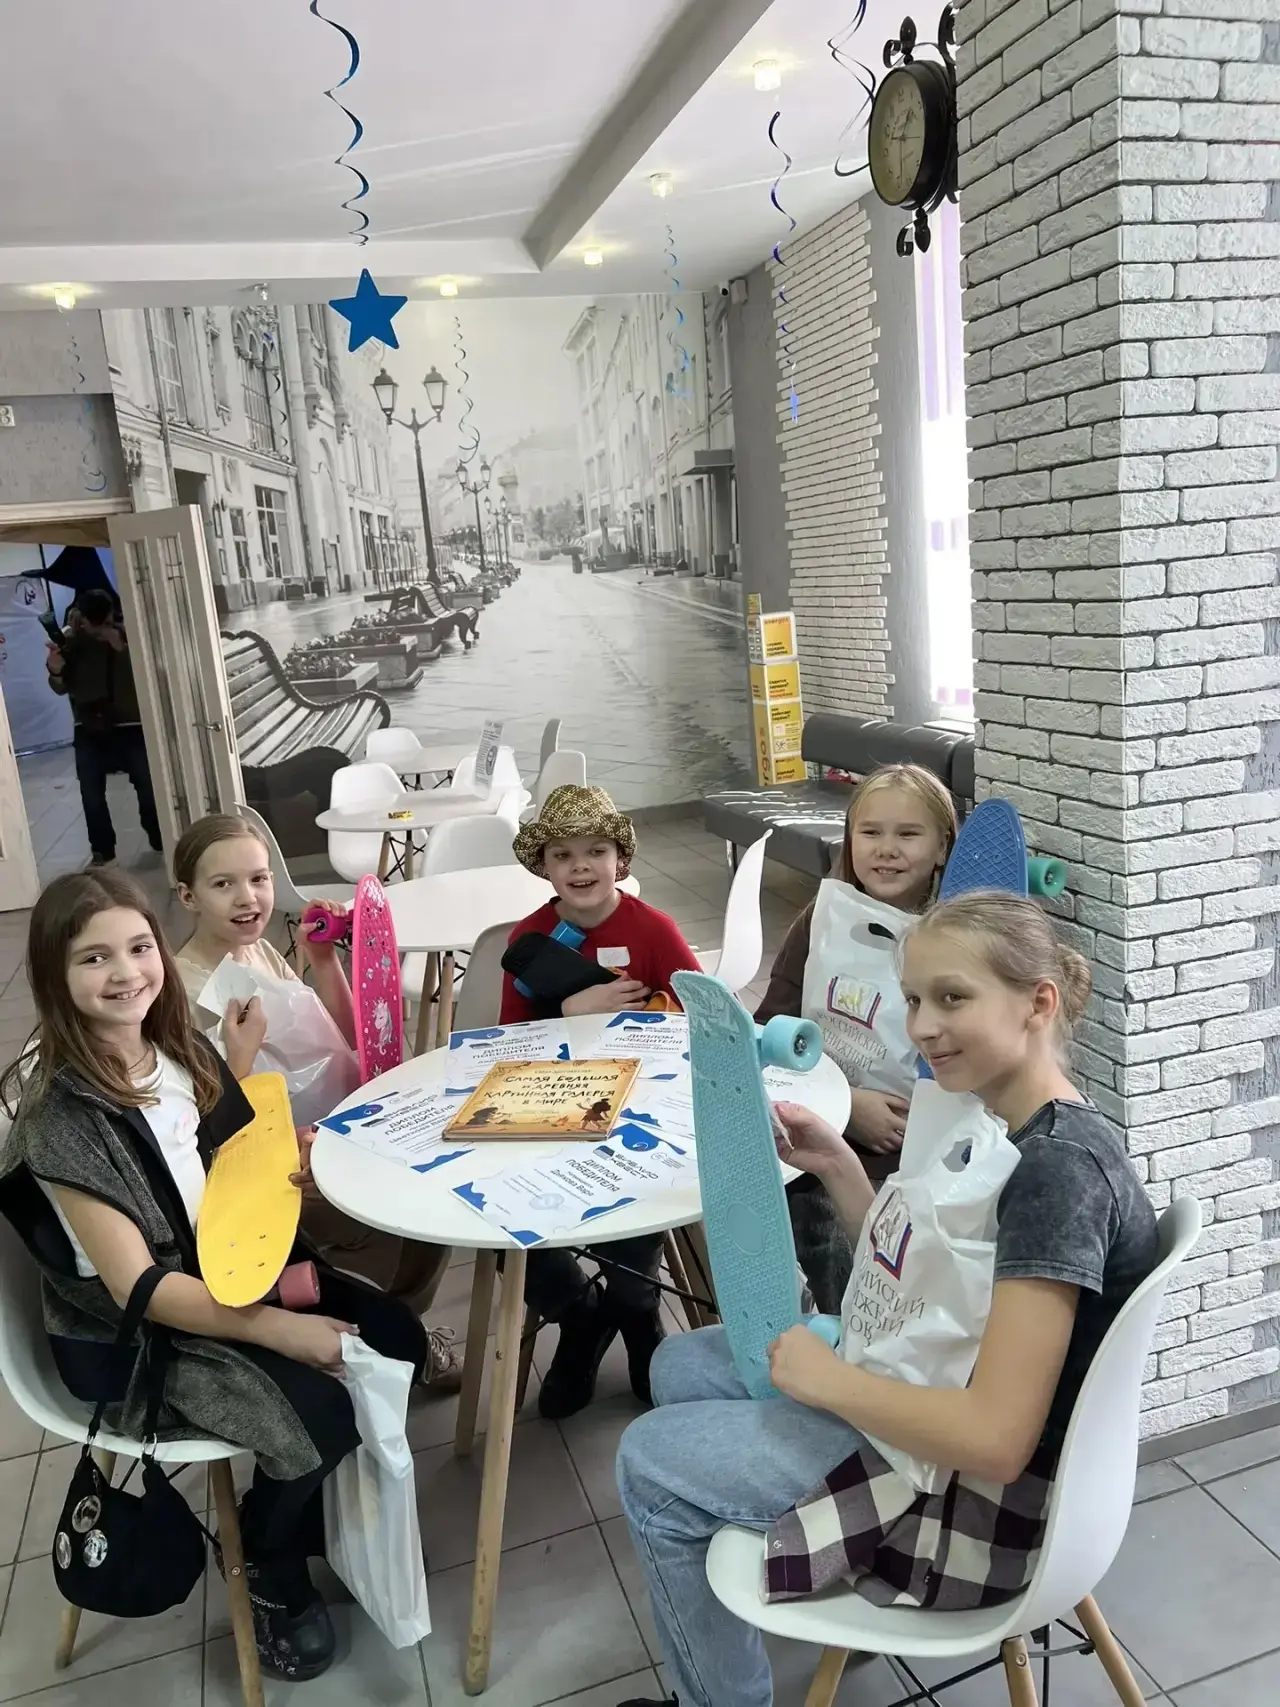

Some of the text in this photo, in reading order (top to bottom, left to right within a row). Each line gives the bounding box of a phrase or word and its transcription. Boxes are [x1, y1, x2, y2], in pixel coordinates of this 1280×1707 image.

[384, 1104, 456, 1136] ПОБЕДИТЕЛЯ
[388, 1106, 437, 1129] ДИПЛОМ
[565, 1158, 621, 1193] ПОБЕДИТЕЛЯ
[581, 1159, 623, 1182] ДИПЛОМ
